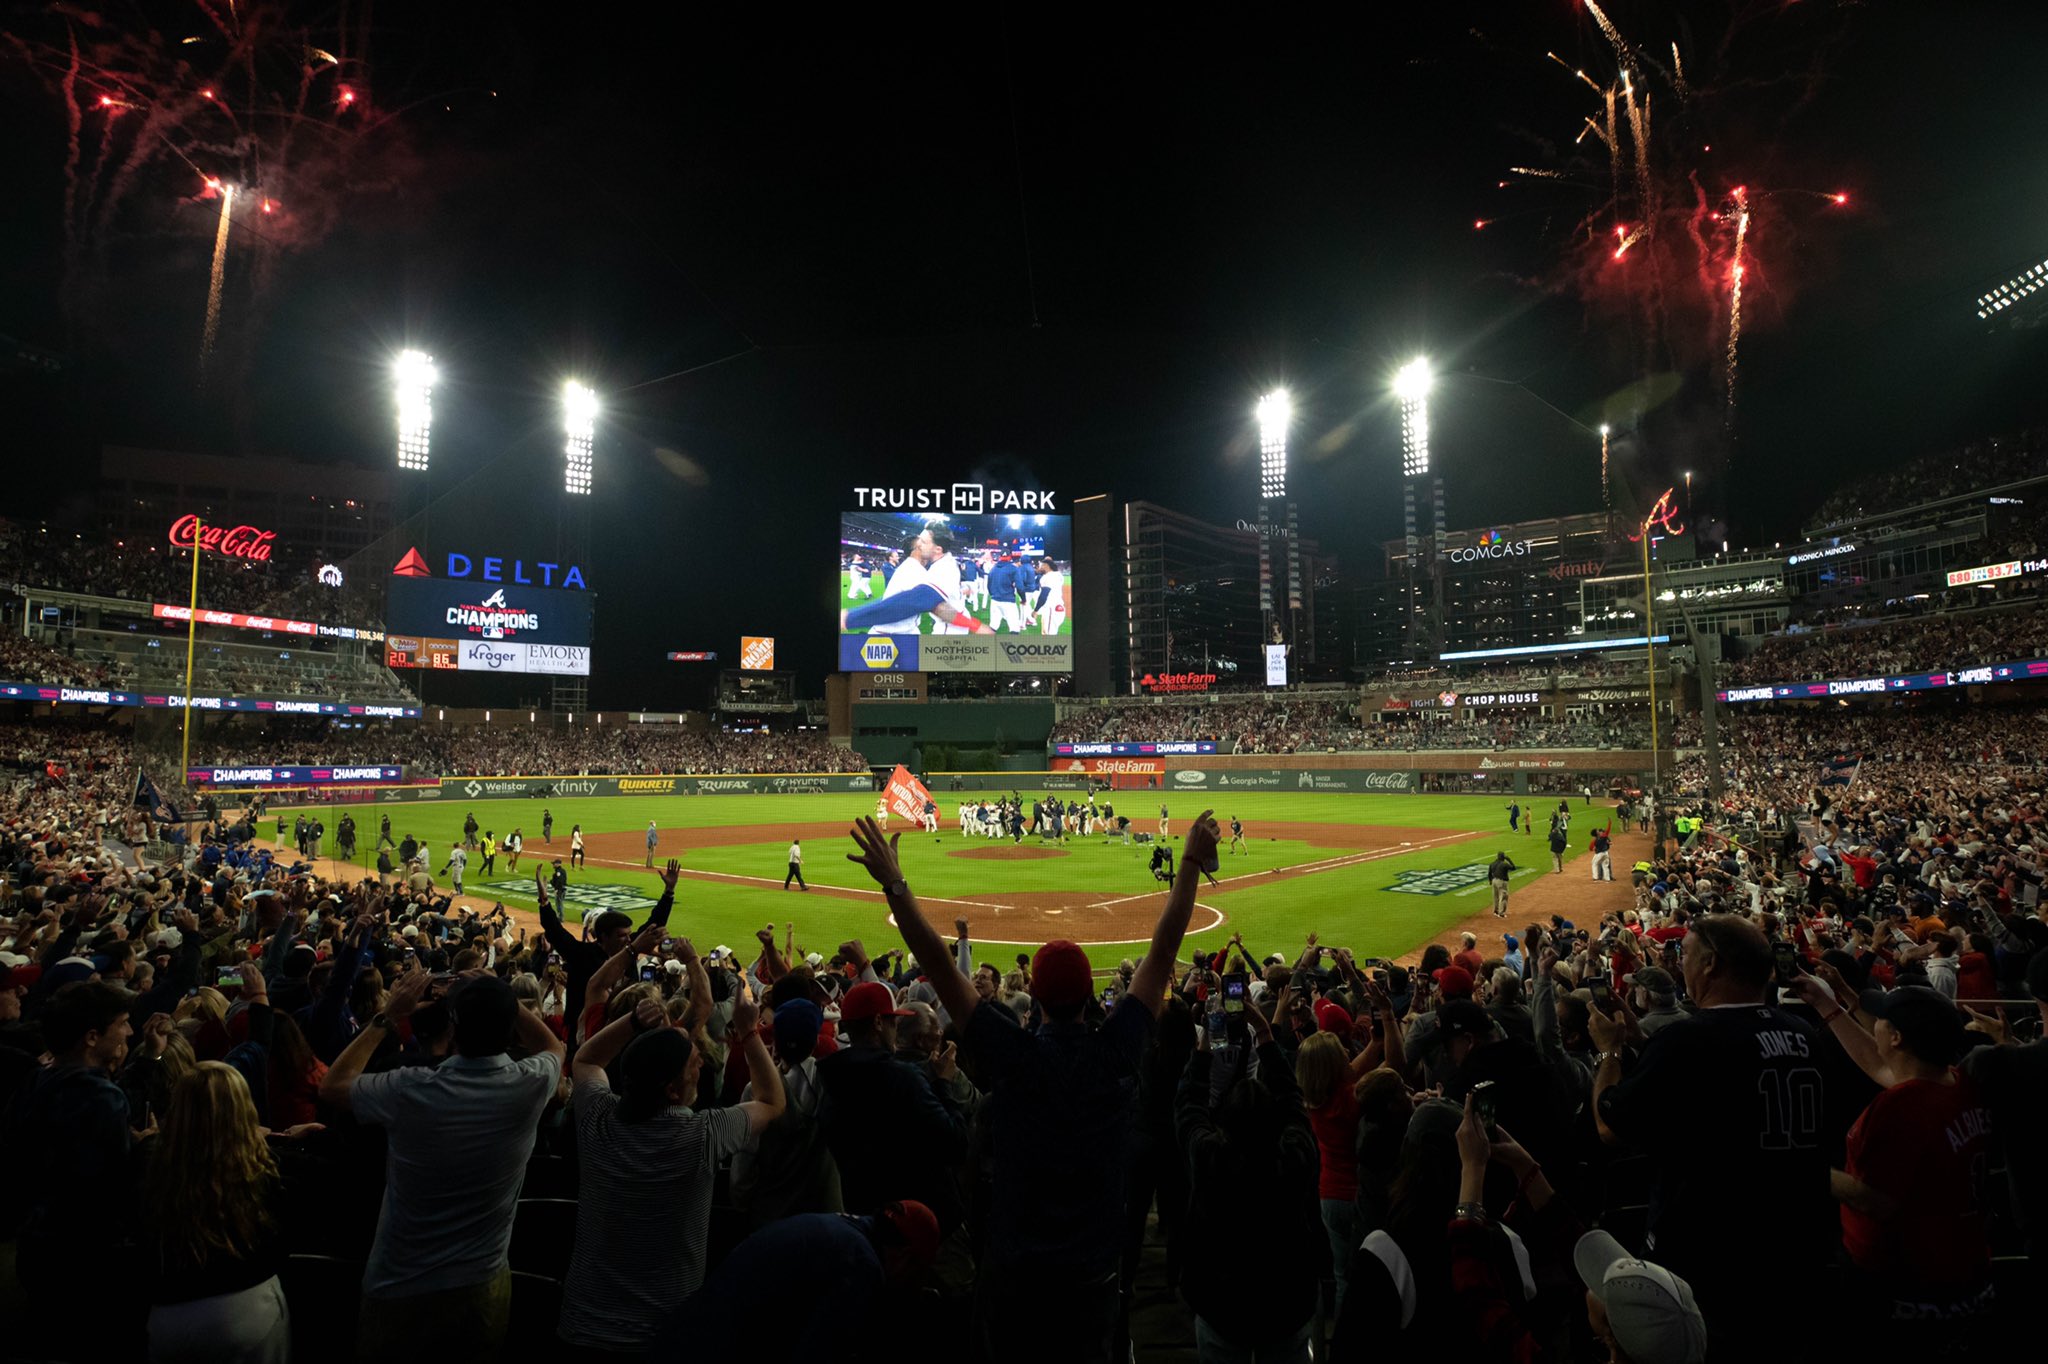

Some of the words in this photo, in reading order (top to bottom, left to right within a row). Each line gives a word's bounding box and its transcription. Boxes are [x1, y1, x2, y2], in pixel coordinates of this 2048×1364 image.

[854, 487, 946, 508] TRUIST
[990, 490, 1056, 510] PARK
[1450, 540, 1535, 563] COMCAST
[1798, 551, 1824, 563] KONICA
[1824, 544, 1856, 557] MINOLTA
[447, 552, 587, 590] DELTA
[1549, 560, 1606, 580] xfinity
[1949, 571, 1971, 585] 680
[1987, 564, 2013, 578] 93.7
[12, 583, 28, 597] 42
[446, 607, 539, 630] CHAMPIONS
[319, 626, 339, 636] 11:44
[469, 643, 516, 668] Kroger
[529, 645, 587, 660] EMORY
[866, 645, 893, 660] NAPA
[924, 646, 990, 654] NORTHSIDE
[1006, 644, 1068, 655] COOLRAY
[389, 651, 406, 662] 20
[433, 653, 450, 664] 86
[873, 673, 905, 684] ORIS
[1829, 678, 1886, 694] CHAMPIONS
[61, 688, 110, 703] CHAMPIONS
[1465, 694, 1495, 705] CHOP
[1499, 693, 1540, 704] HOUSE
[1590, 690, 1630, 700] Silver
[1727, 687, 1774, 701] CHAMPIONS
[168, 695, 221, 709] CHAMPIONS
[275, 701, 320, 712] CHAMPIONS
[1410, 699, 1436, 707] LIGHT
[365, 705, 403, 717] CHAMPIONS
[1073, 744, 1112, 754] CHAMPIONS
[1156, 743, 1197, 753] CHAMPIONS
[213, 769, 273, 782] CHAMPIONS
[333, 768, 382, 780] CHAMPIONS
[485, 782, 527, 791] Wellstar
[551, 779, 598, 796] xfinity
[618, 779, 676, 789] QUIKRETE
[698, 780, 751, 790] EQUIFAX
[1230, 777, 1257, 786] Georgia
[1258, 777, 1280, 785] Power
[1755, 1031, 1810, 1060] JONES
[1757, 1067, 1825, 1151] 10
